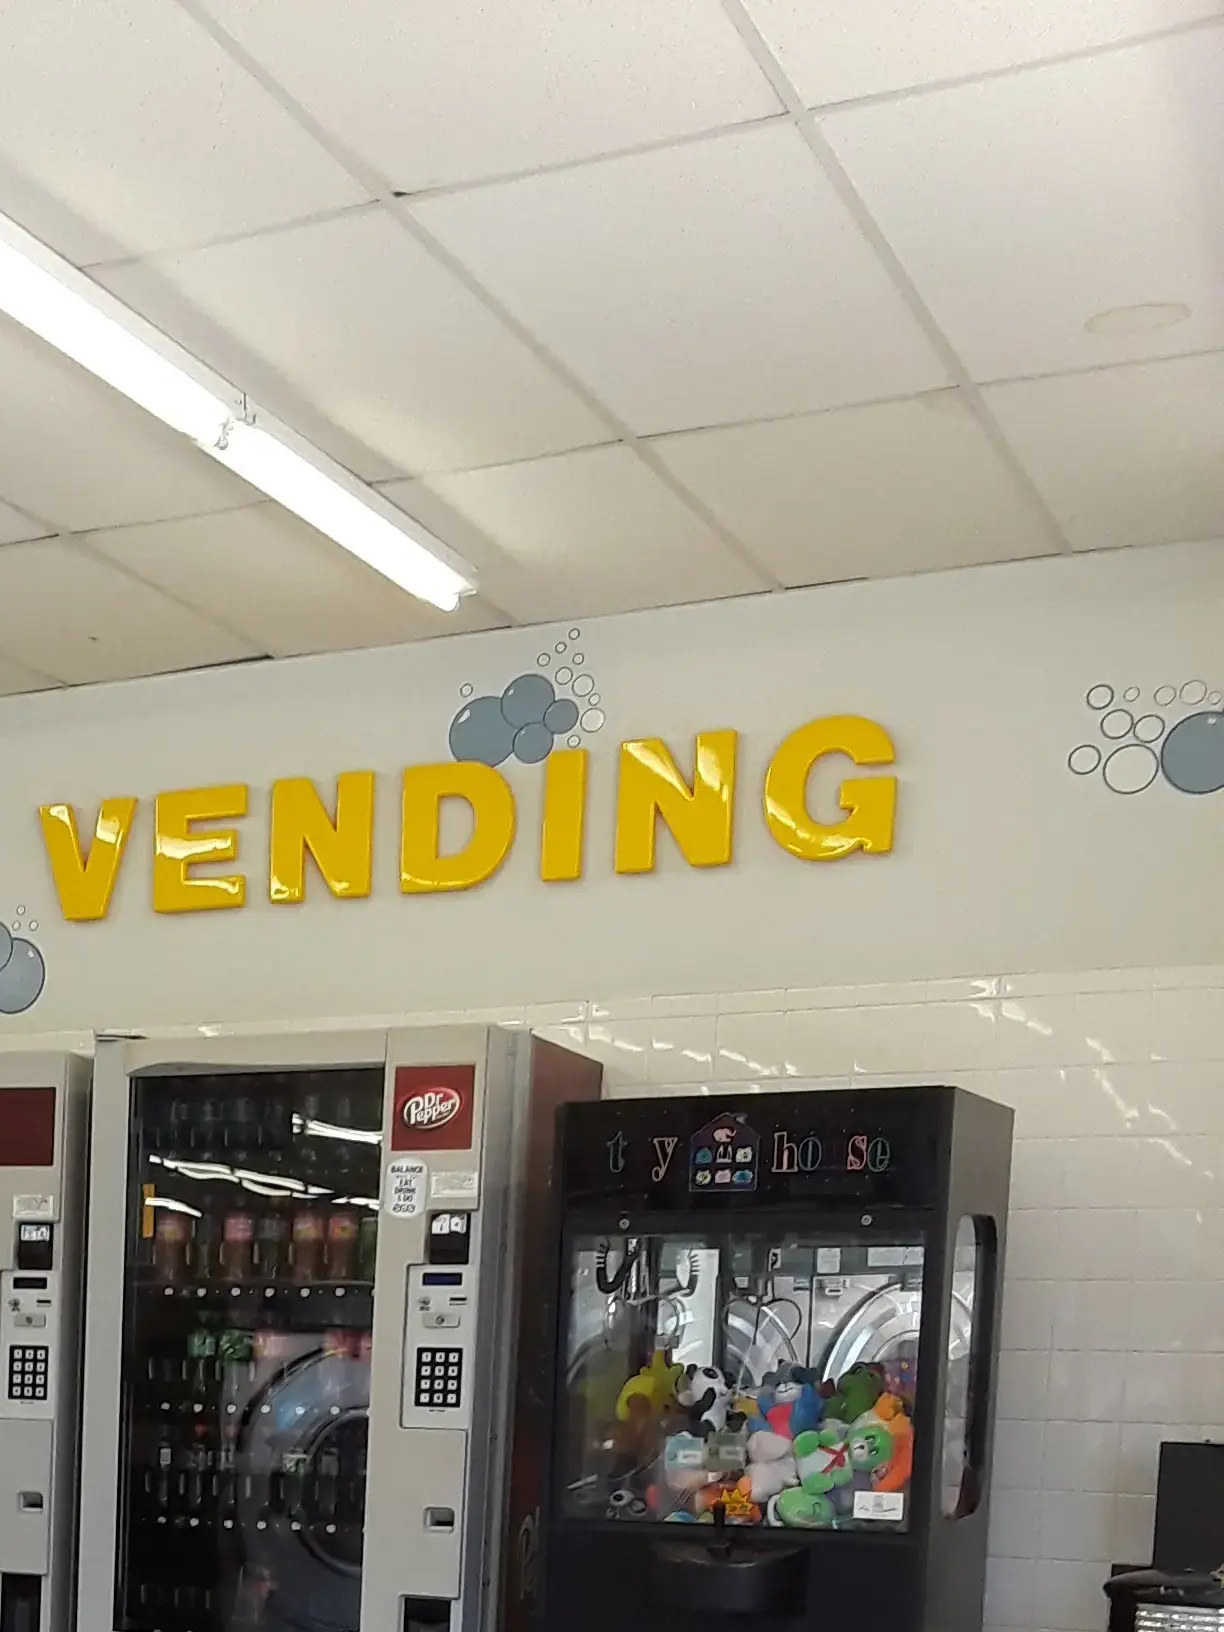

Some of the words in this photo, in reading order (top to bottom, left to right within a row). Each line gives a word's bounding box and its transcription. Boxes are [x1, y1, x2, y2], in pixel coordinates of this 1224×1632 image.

[38, 714, 898, 921] VENDING
[404, 1096, 457, 1125] Pepper
[424, 1092, 444, 1108] Dr
